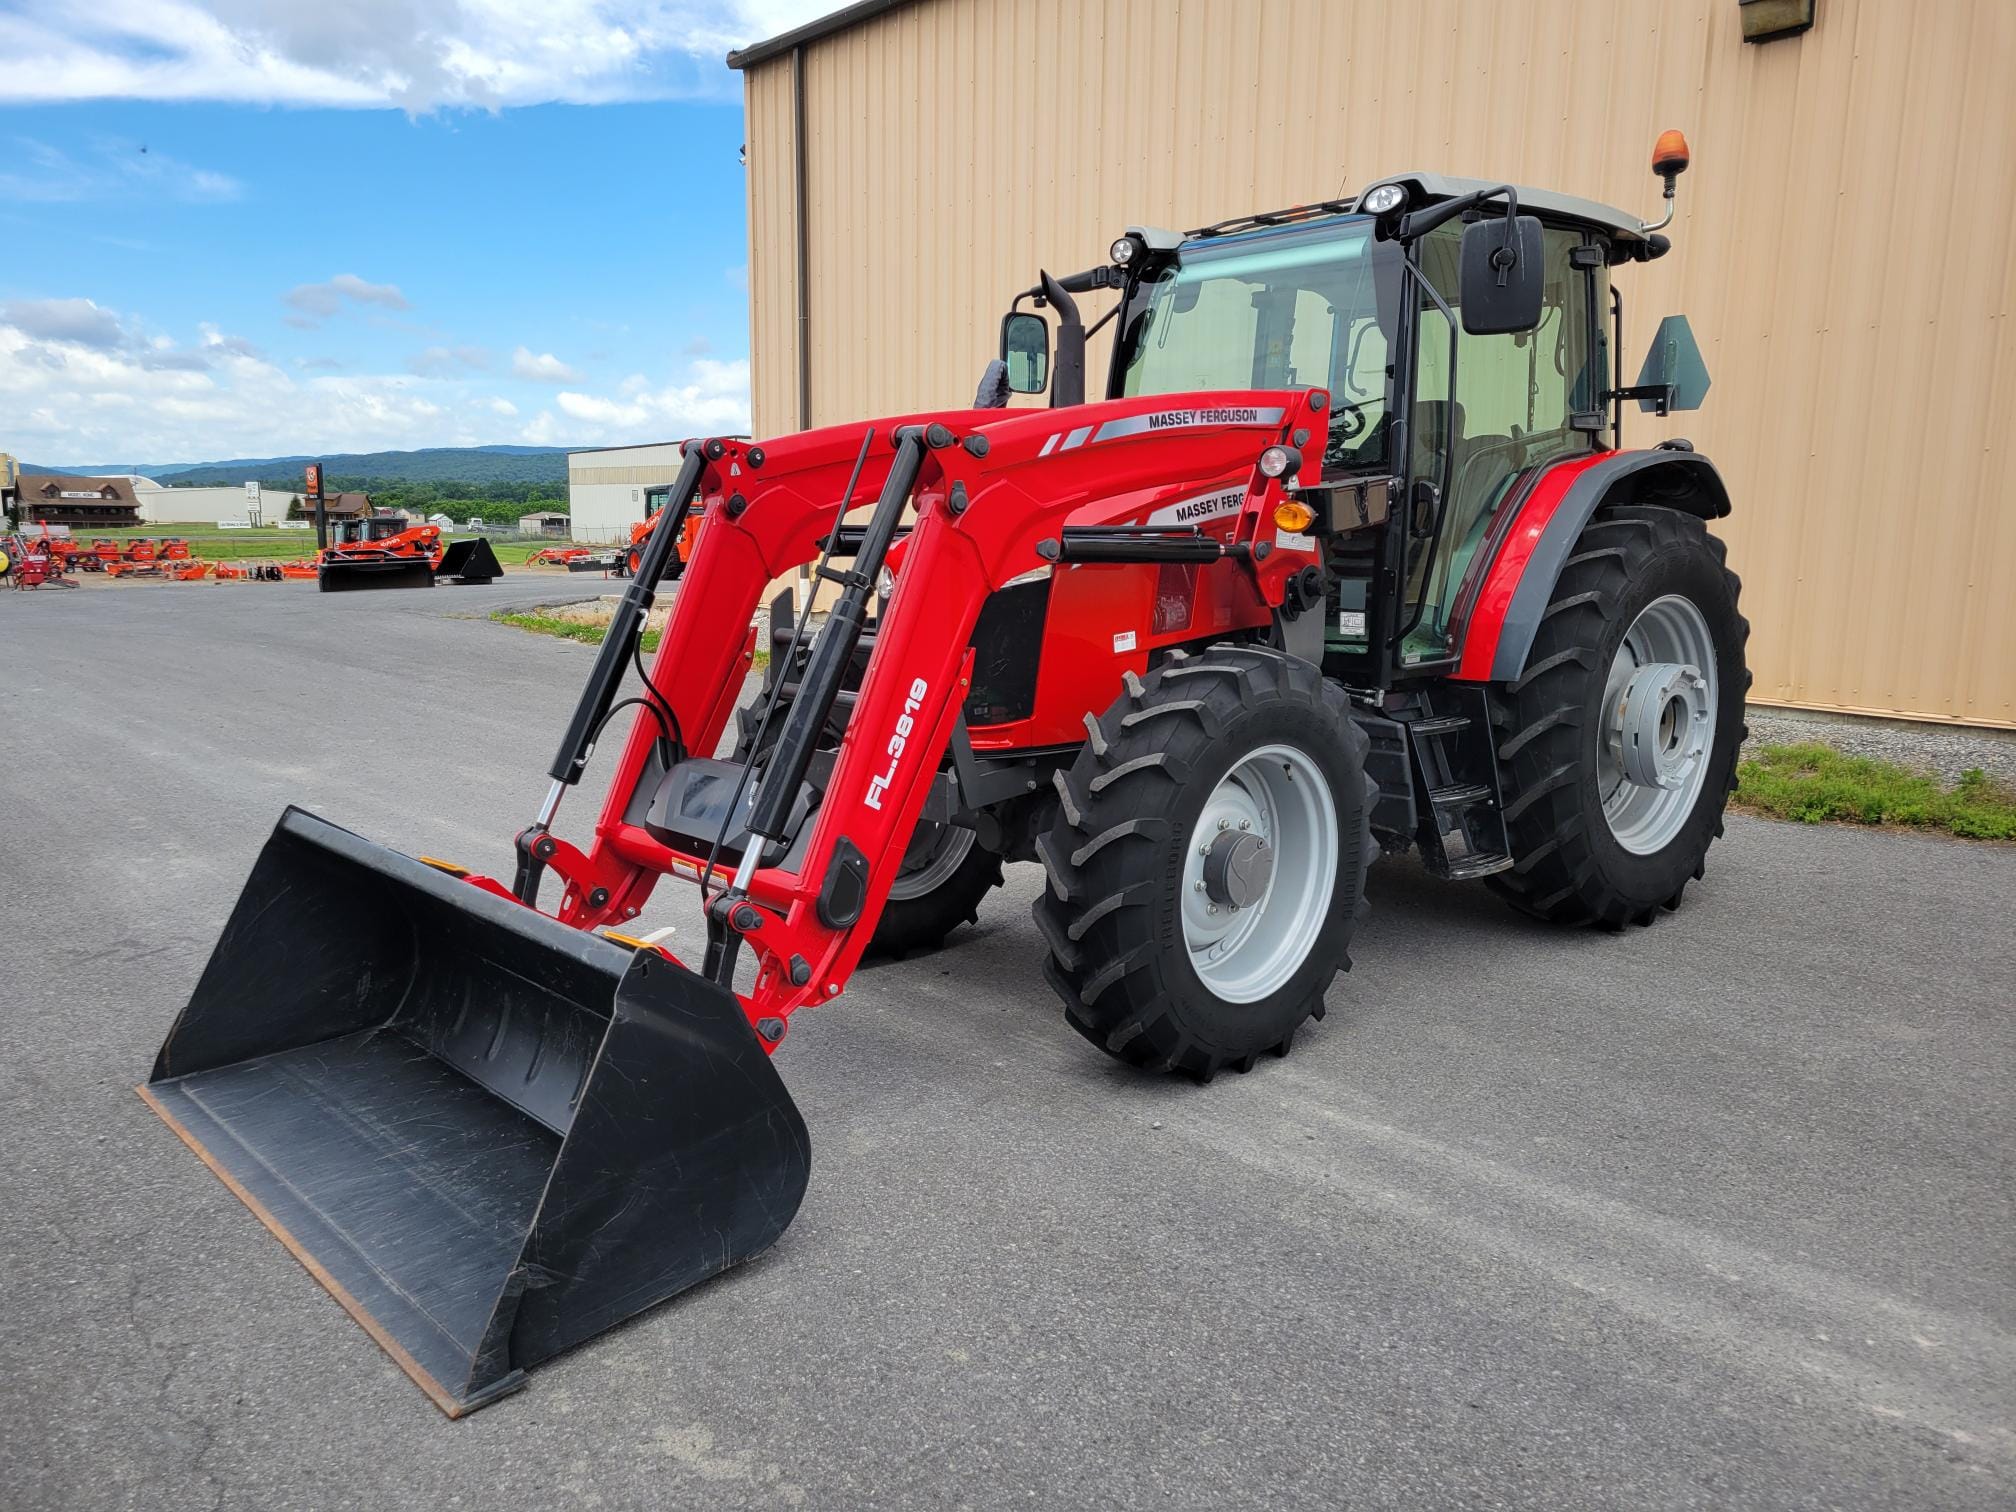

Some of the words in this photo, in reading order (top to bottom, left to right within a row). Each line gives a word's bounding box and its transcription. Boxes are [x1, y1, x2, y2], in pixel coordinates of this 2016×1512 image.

[1149, 411, 1197, 429] MASSEY
[1200, 409, 1257, 423] FERGUSON
[1176, 498, 1218, 522] MASSEY
[1221, 492, 1245, 509] FERG
[863, 677, 928, 811] FL.3819
